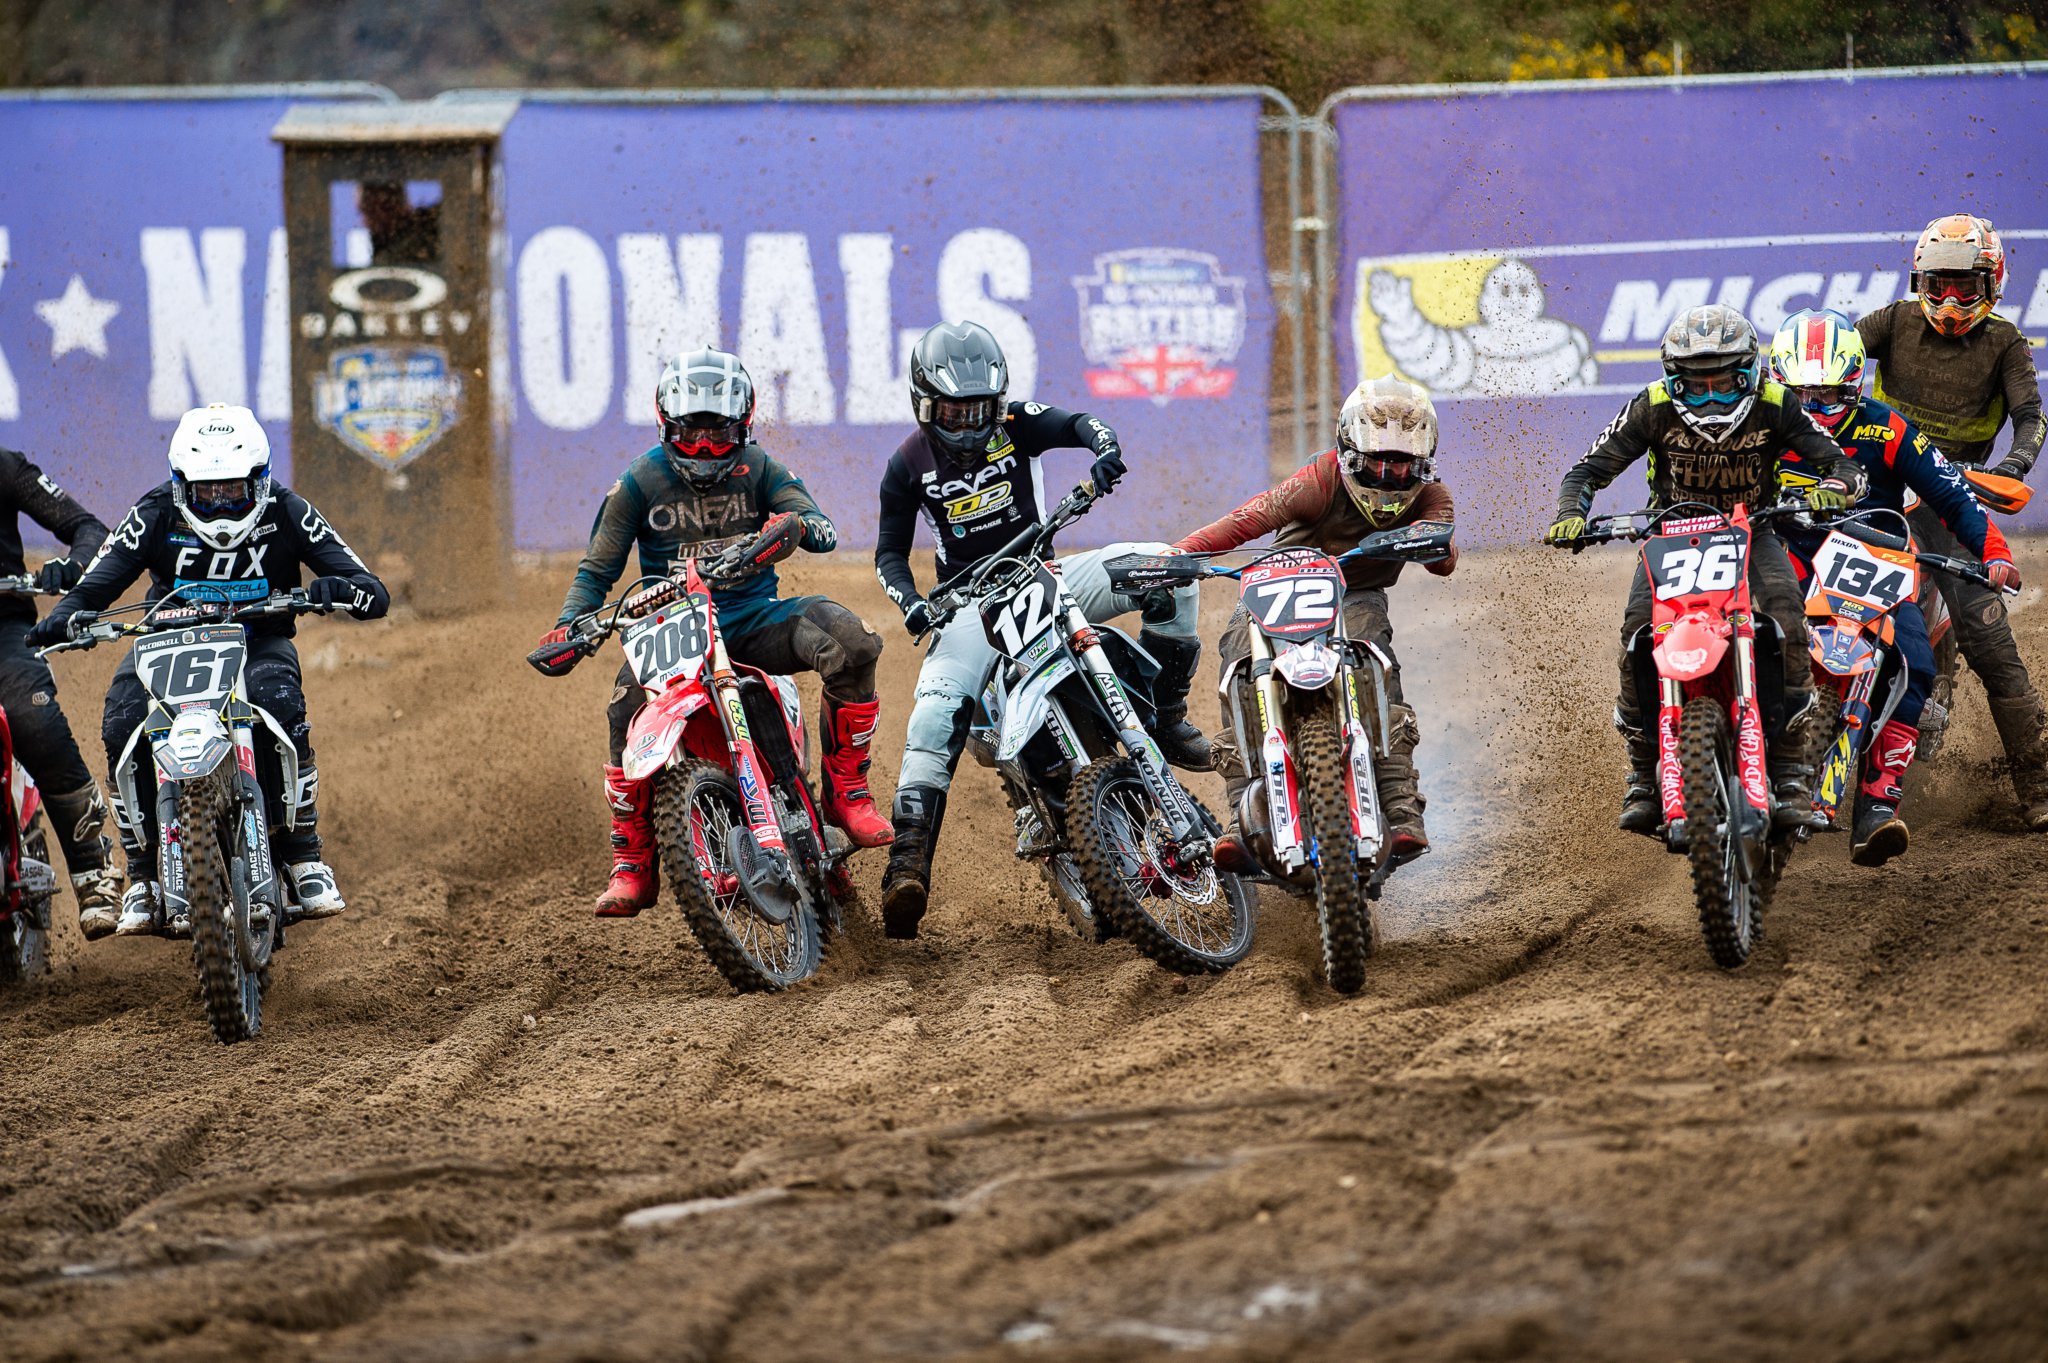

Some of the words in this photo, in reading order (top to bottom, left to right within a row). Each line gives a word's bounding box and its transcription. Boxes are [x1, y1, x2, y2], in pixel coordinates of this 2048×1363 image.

[140, 226, 1037, 431] NONALS
[208, 424, 230, 432] Arai
[1918, 422, 1949, 437] EATING
[175, 544, 269, 580] FOX
[755, 541, 783, 564] CIRCUIT
[1831, 537, 1859, 550] DIXON
[627, 573, 687, 608] RENTHA
[1128, 570, 1168, 578] Polisport
[1244, 568, 1272, 584] 723
[1656, 545, 1747, 601] 36
[1823, 551, 1906, 608] 134
[992, 582, 1054, 659] 12
[1257, 579, 1334, 626] 72
[138, 638, 179, 651] McCORKELL
[549, 649, 576, 667] CIRCUIT
[634, 611, 709, 687] 208
[147, 647, 245, 702] 161
[1164, 770, 1193, 815] SYNTOL
[1354, 756, 1372, 818] DEP
[1663, 765, 1682, 812] CHAOS
[160, 822, 170, 888] DUNLOP
[255, 808, 273, 875] DUNLOP
[175, 859, 184, 892] BRACE
[248, 850, 260, 882] BRACE
